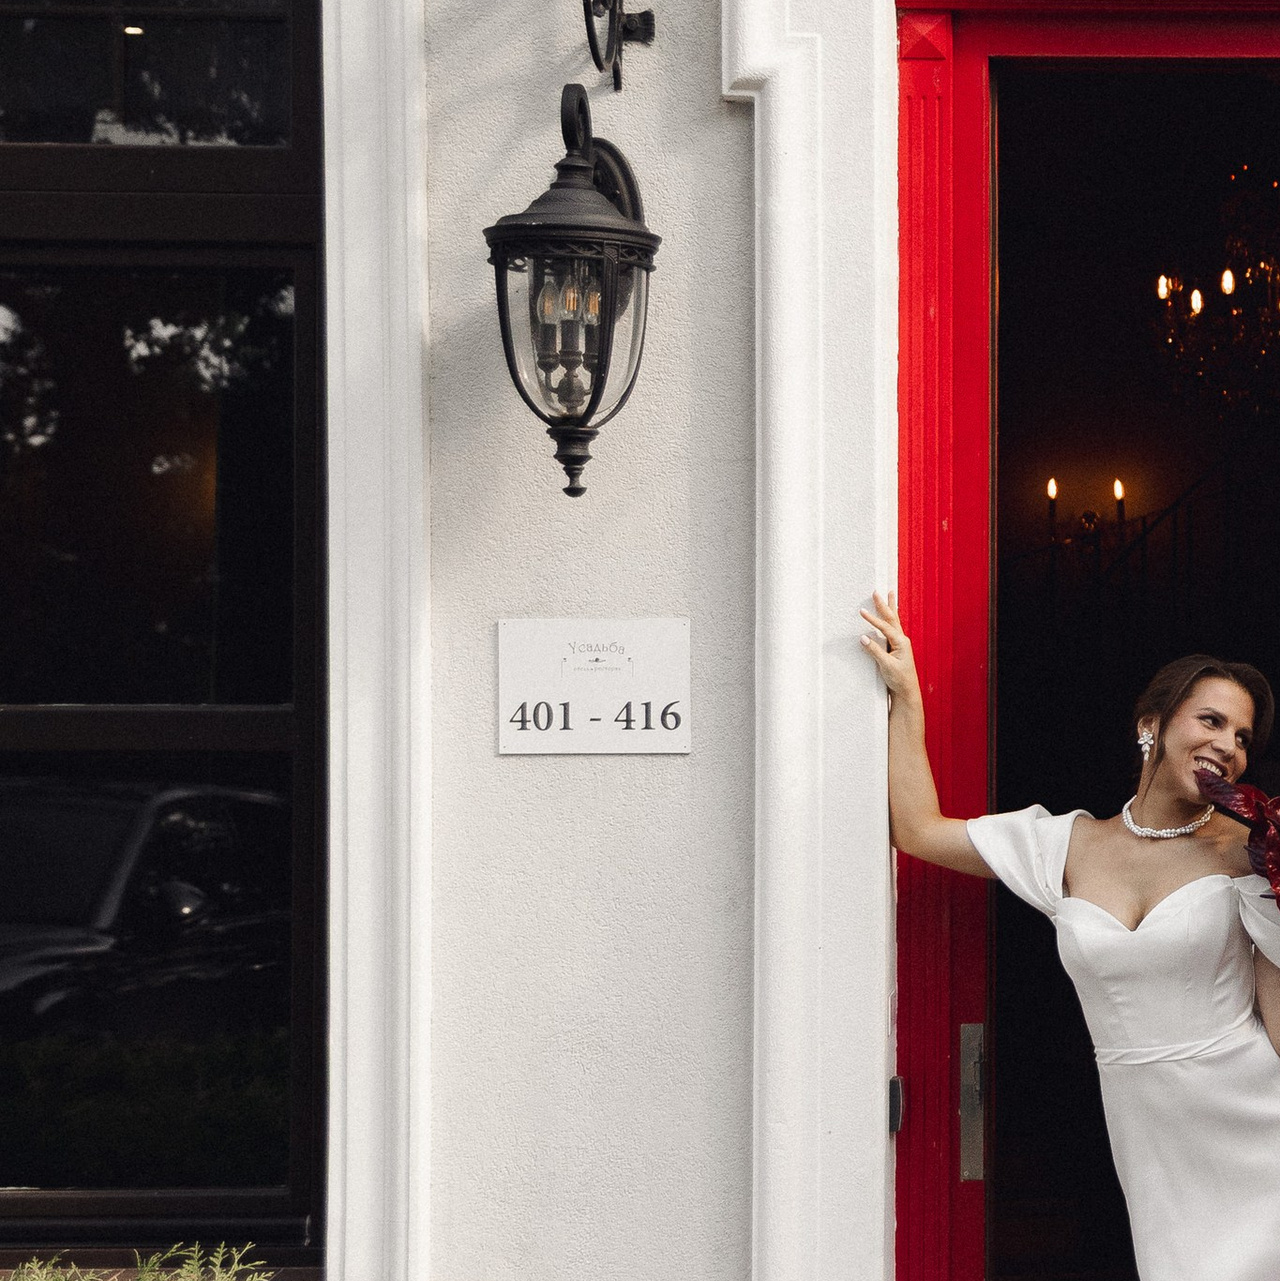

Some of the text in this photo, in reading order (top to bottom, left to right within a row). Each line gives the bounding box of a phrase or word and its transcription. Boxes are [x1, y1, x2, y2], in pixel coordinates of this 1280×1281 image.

[568, 641, 625, 655] Усадьба
[509, 701, 574, 731] 401
[614, 700, 682, 731] 416
